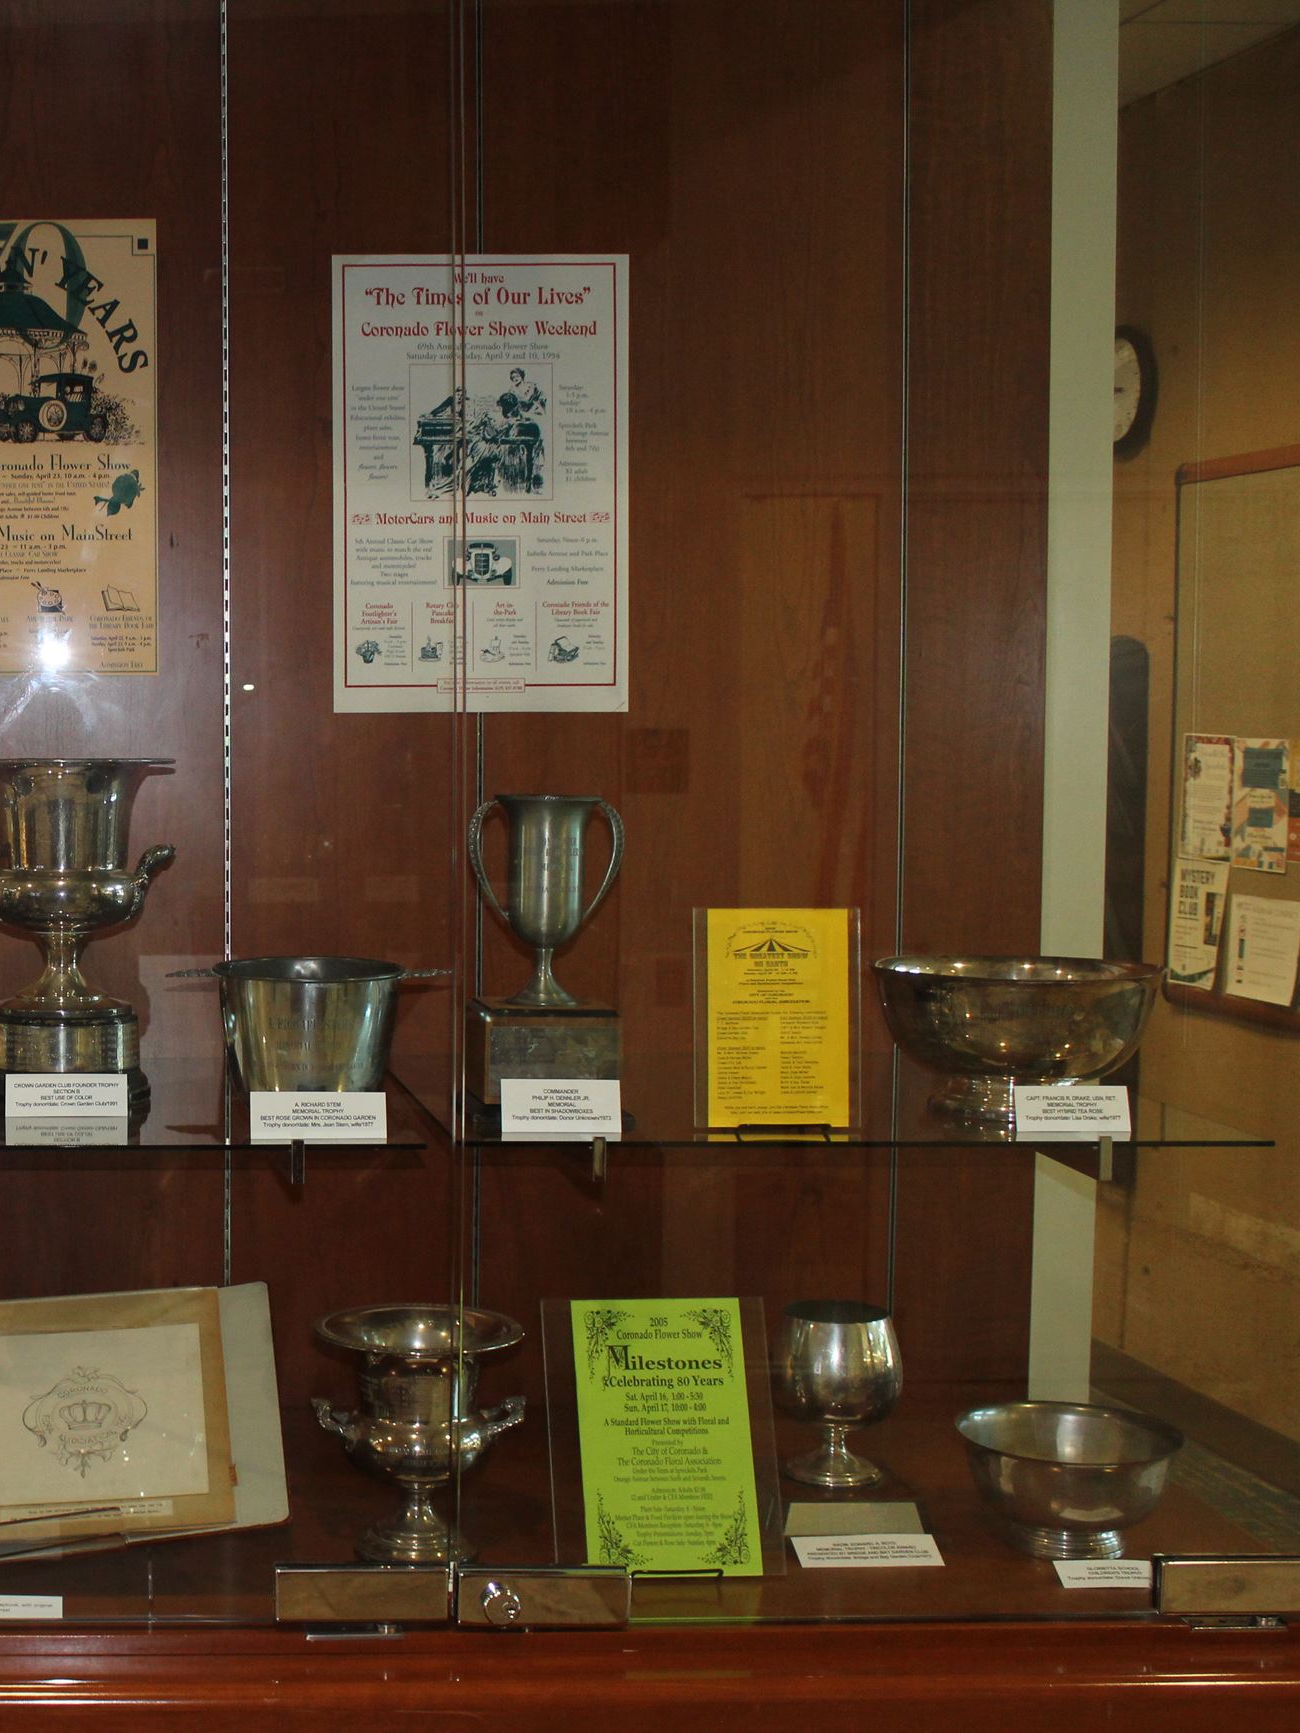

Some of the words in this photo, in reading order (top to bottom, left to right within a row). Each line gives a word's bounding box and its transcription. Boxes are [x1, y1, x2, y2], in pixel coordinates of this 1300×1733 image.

[481, 273, 504, 284] have
[473, 288, 490, 305] of
[497, 286, 530, 305] Our
[55, 256, 149, 374] YEARS
[361, 322, 429, 338] Coronado
[489, 321, 528, 338] Show
[535, 321, 596, 338] Weekend
[486, 352, 502, 361] April
[512, 352, 526, 360] and
[50, 454, 91, 471] Flower
[97, 454, 131, 471] Show
[376, 513, 435, 525] MotorCars
[465, 513, 498, 524] Music
[503, 516, 515, 525] on
[521, 512, 549, 524] Main
[554, 512, 586, 523] Street
[41, 532, 54, 541] on
[62, 524, 132, 541] MainStreet
[650, 1318, 668, 1327] 2005
[617, 1330, 653, 1340] Coronado
[655, 1329, 680, 1339] Flower
[682, 1329, 702, 1339] Show
[605, 1345, 722, 1370] Milestones
[609, 1376, 673, 1388] Celebrating
[677, 1376, 689, 1386] 80
[691, 1376, 724, 1386] Years
[625, 1393, 637, 1401] Sat.
[640, 1392, 657, 1402] April
[624, 1404, 639, 1412] Sun.
[642, 1404, 659, 1414] April
[604, 1418, 609, 1426] A
[718, 1417, 729, 1425] and
